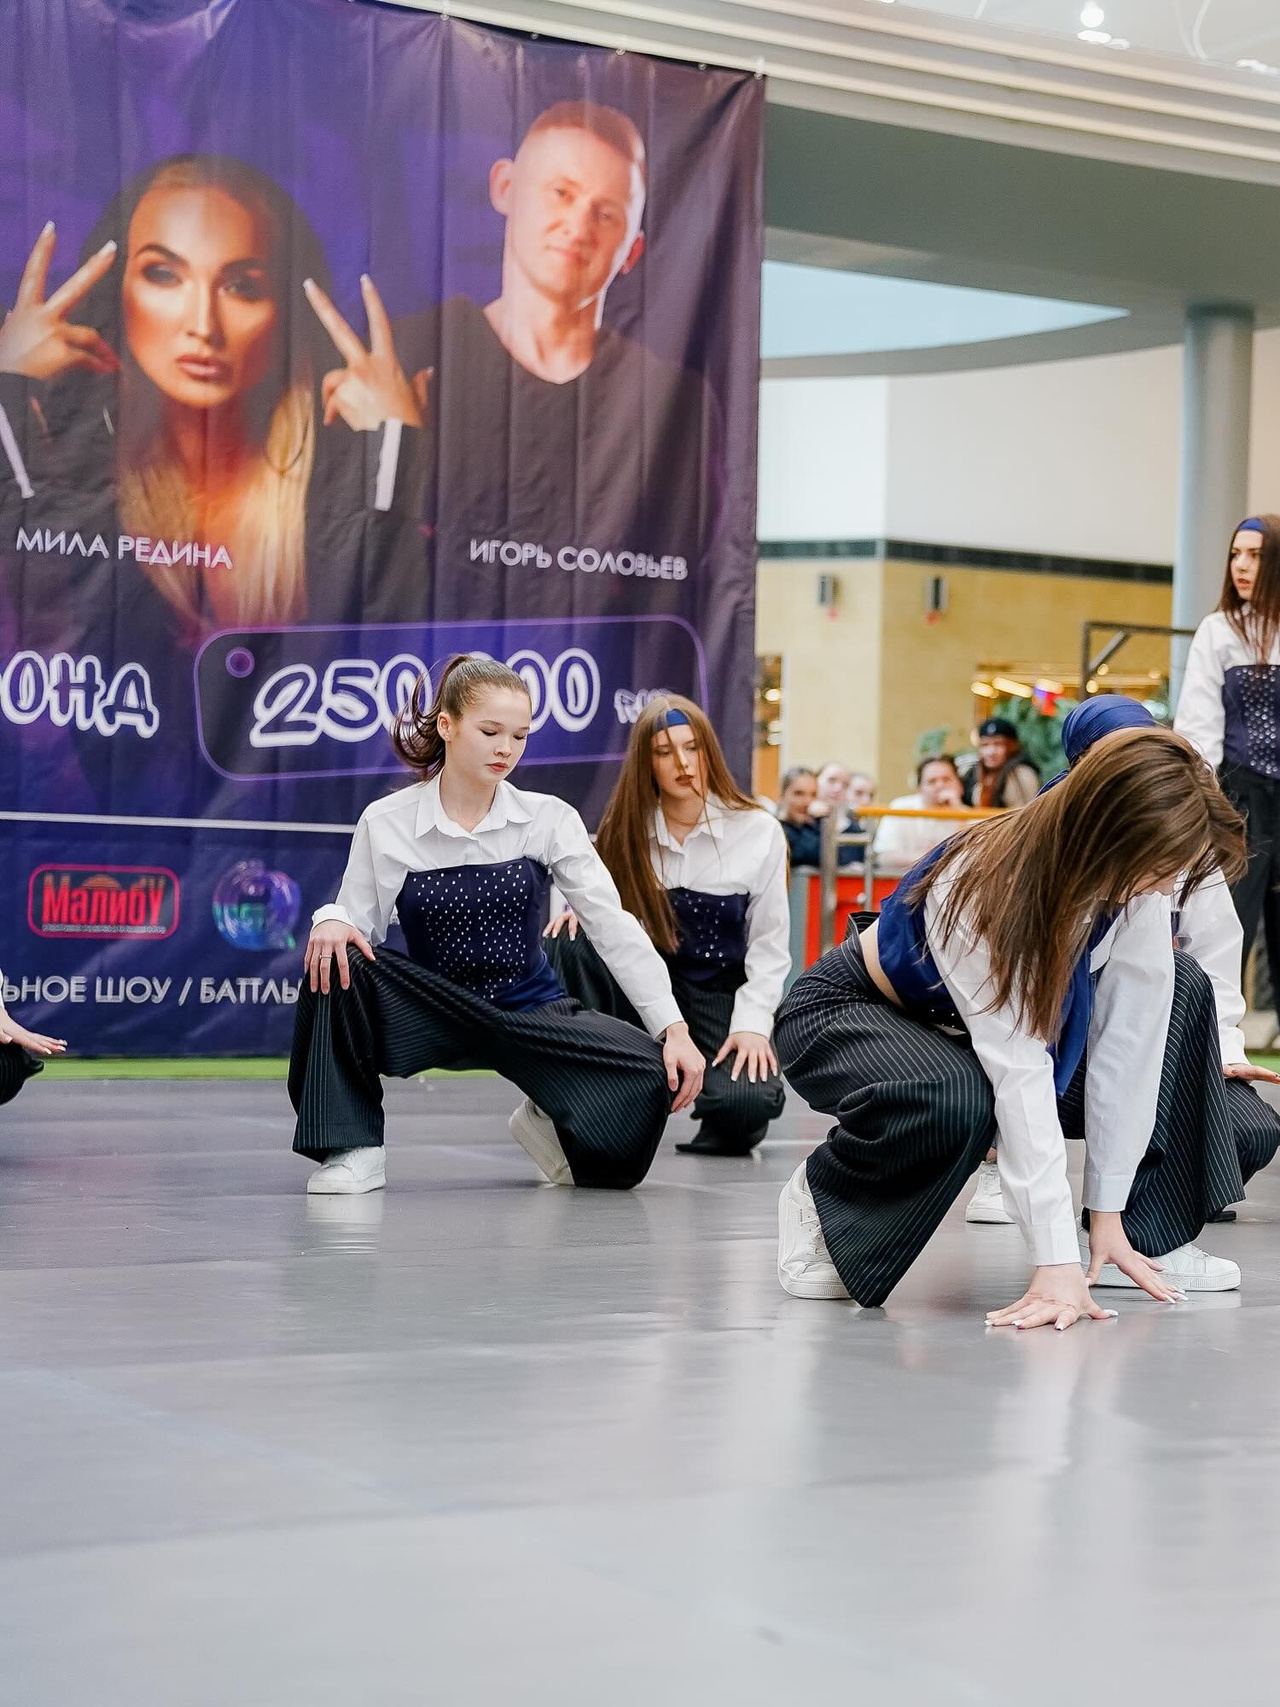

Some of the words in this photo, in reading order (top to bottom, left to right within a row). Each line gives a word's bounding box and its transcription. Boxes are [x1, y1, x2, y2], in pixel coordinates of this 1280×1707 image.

[16, 527, 110, 559] МИЛА
[117, 534, 234, 570] РЕДИНА
[469, 537, 552, 569] ИГОРЬ
[556, 546, 688, 581] СОЛОВЬЕВ
[95, 976, 172, 1004] ШОУ
